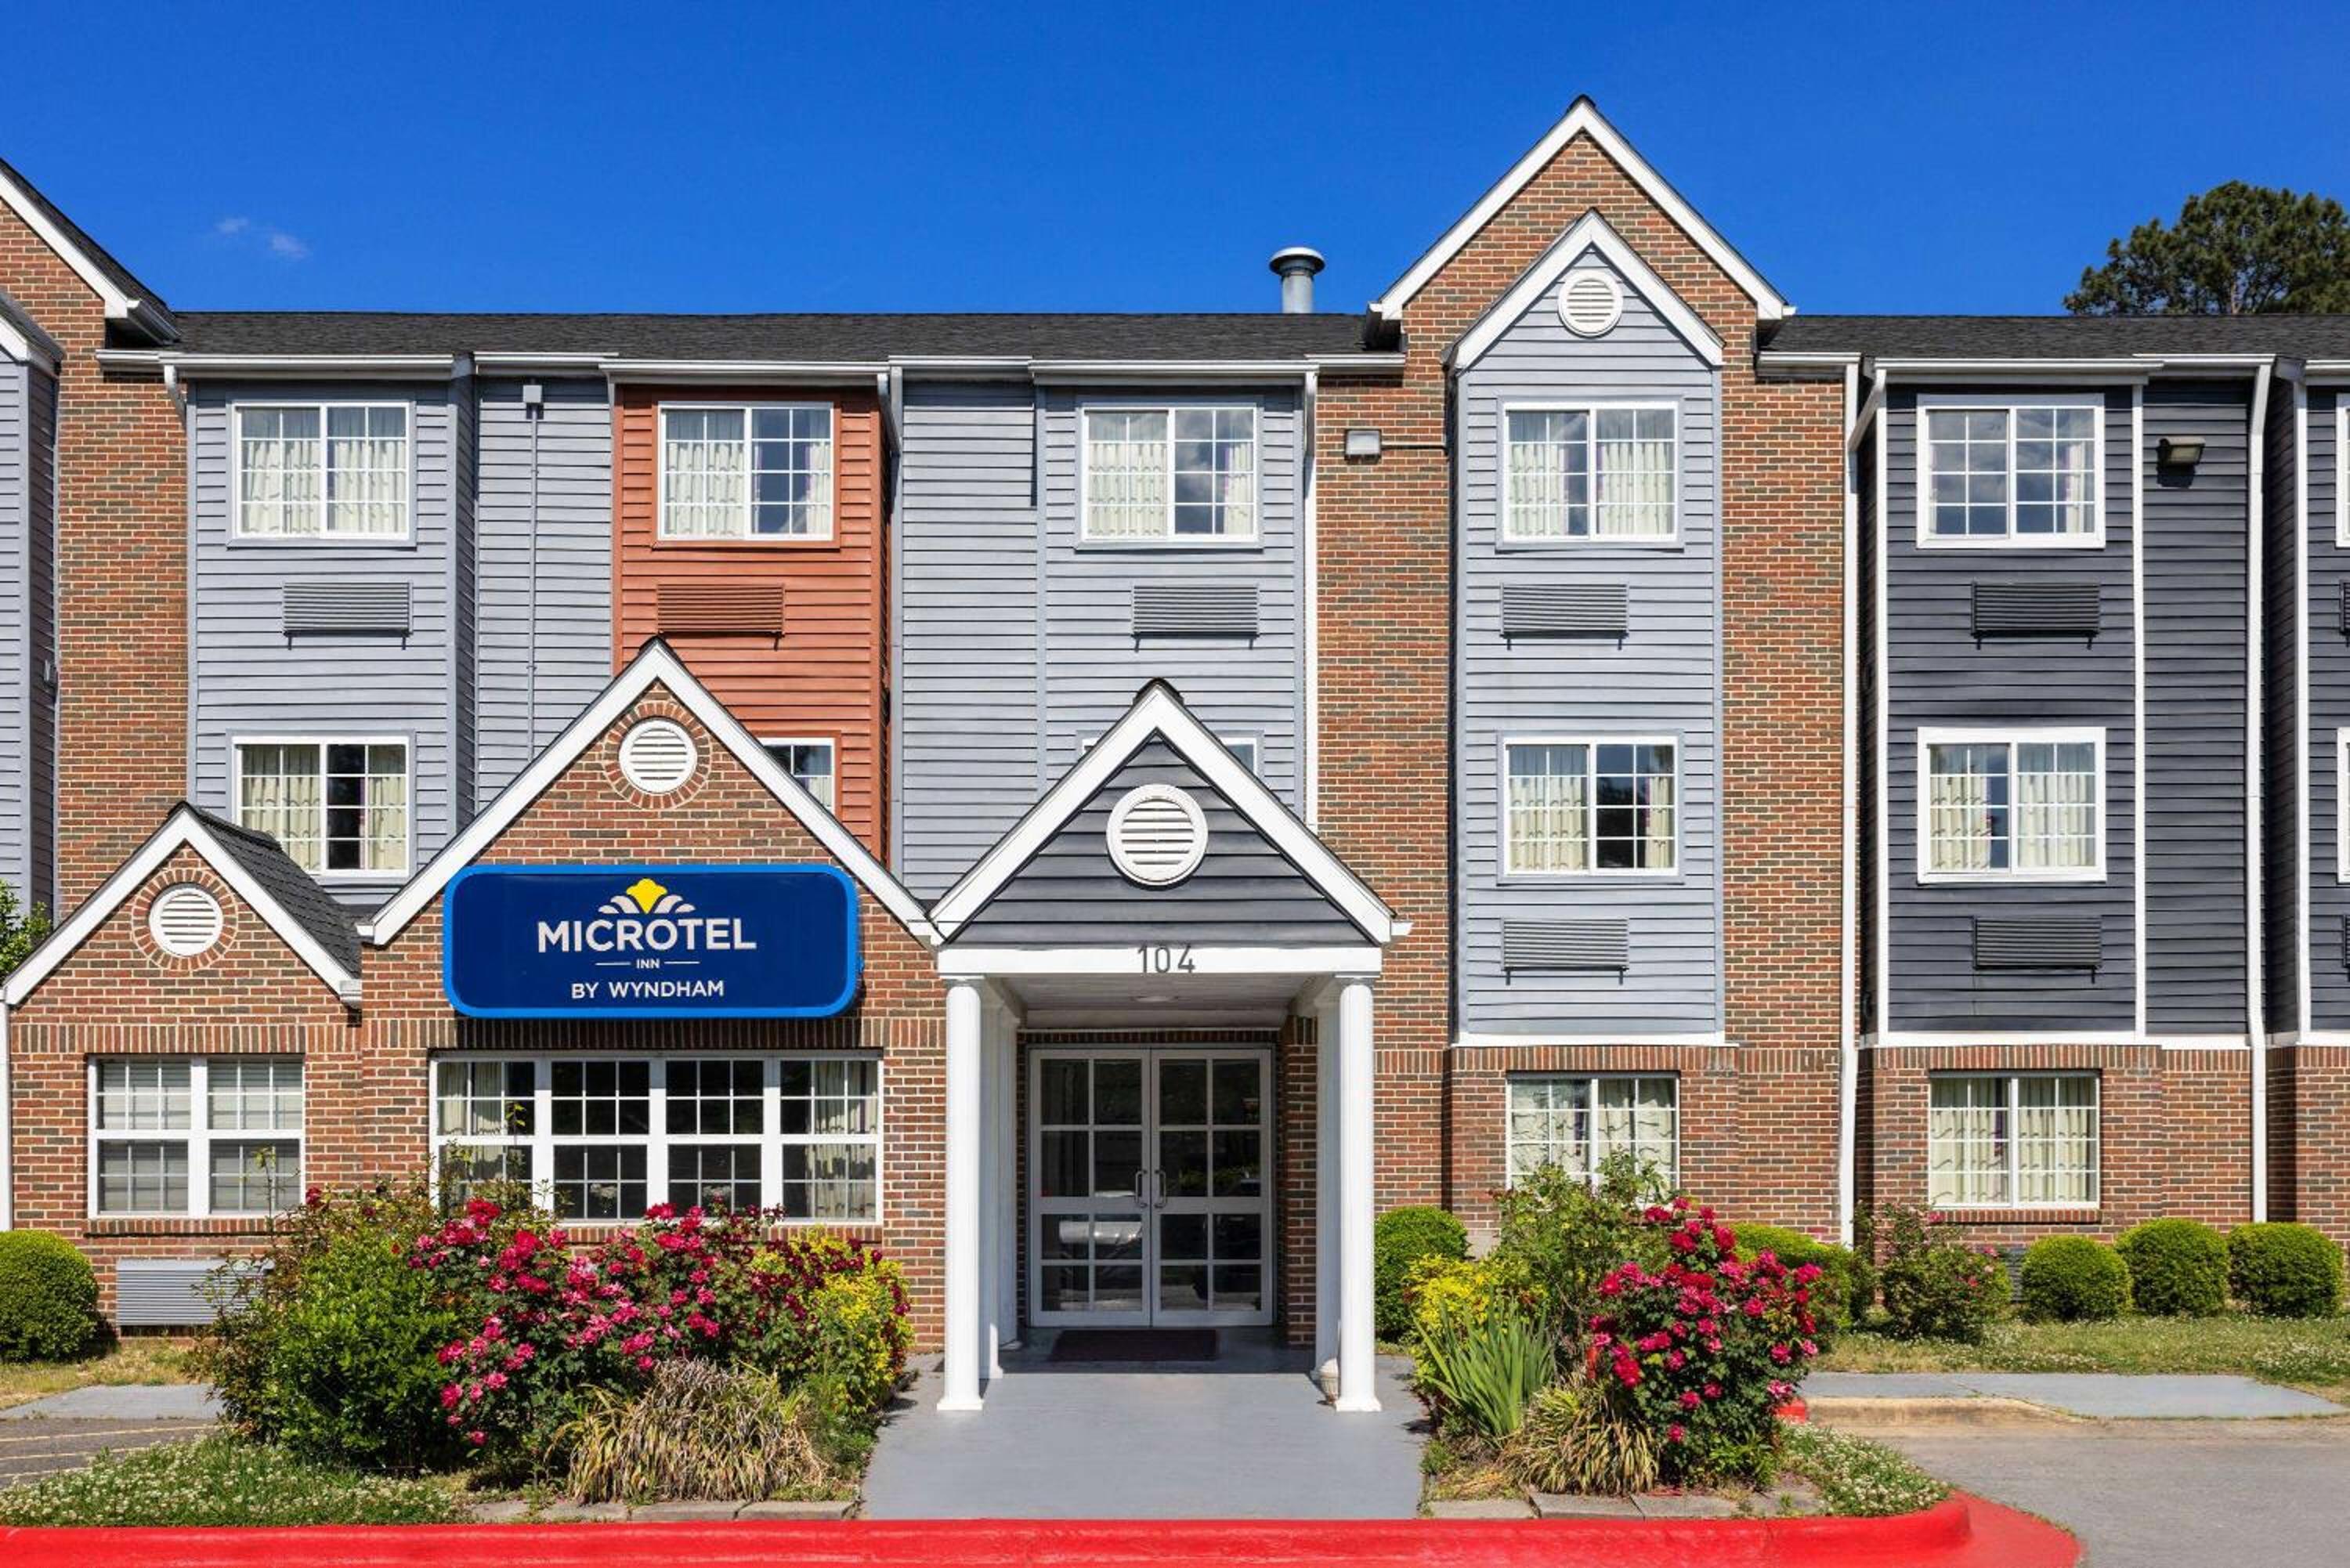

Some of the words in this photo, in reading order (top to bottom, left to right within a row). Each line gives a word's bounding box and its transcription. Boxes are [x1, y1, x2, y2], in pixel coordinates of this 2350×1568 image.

[538, 919, 756, 952] MICROTEL
[637, 959, 660, 968] INN
[1138, 942, 1195, 974] 104
[572, 982, 598, 999] BY
[609, 981, 723, 997] WYNDHAM
